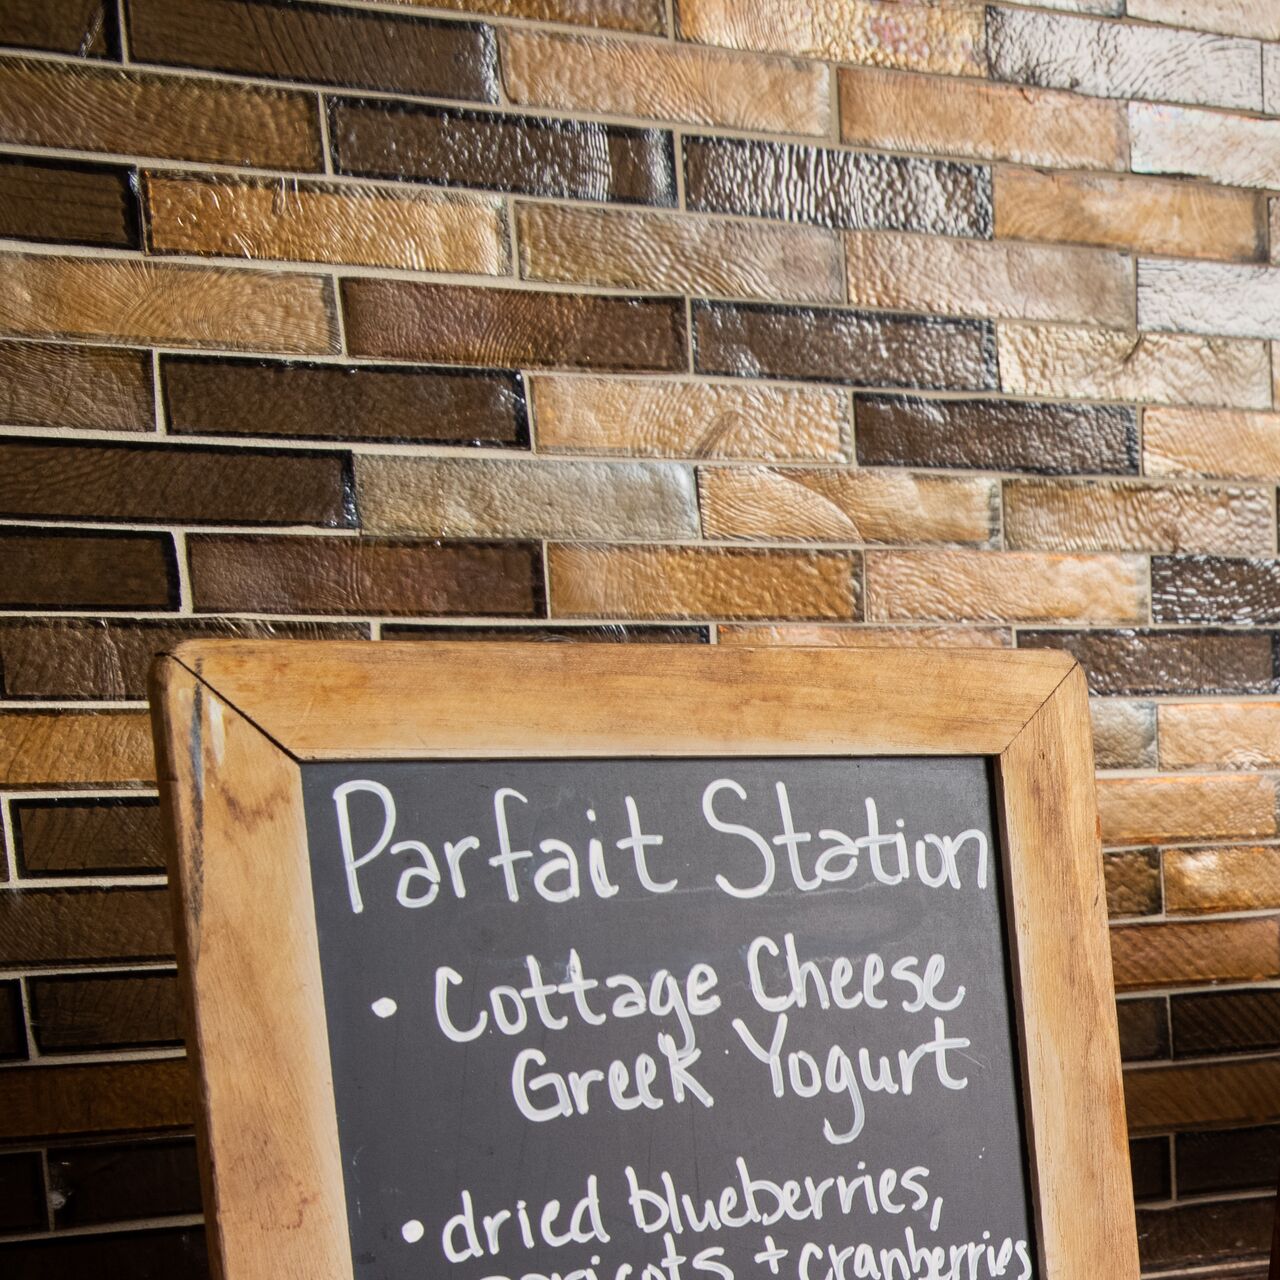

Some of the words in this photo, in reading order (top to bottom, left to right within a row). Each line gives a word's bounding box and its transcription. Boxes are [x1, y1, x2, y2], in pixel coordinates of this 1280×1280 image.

[332, 779, 679, 914] Parfait
[701, 777, 989, 899] Station
[434, 947, 722, 1056] Cottage
[746, 932, 967, 1014] Cheese
[511, 1031, 714, 1123] Greek
[731, 1011, 971, 1146] Yogurt
[441, 1174, 611, 1264] dried
[624, 1155, 944, 1235] blueberries,
